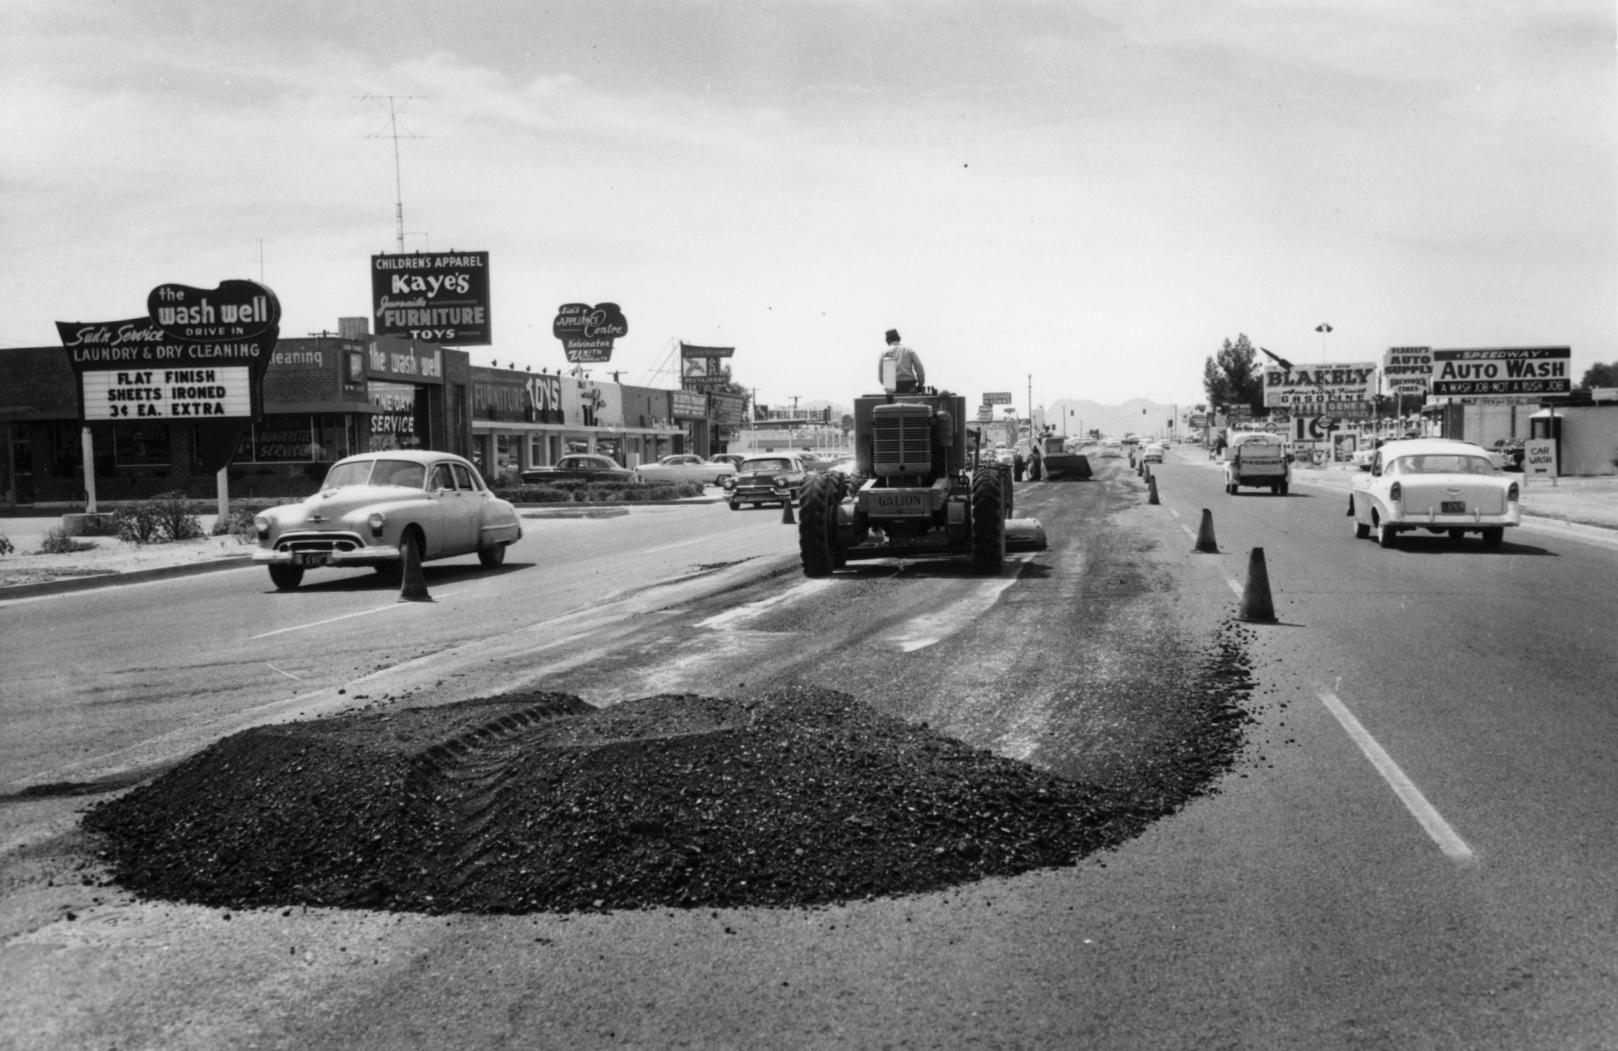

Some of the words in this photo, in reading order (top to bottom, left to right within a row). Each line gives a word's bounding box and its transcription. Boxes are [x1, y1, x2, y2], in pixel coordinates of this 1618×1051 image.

[376, 257, 432, 270] CHILDREN'S
[434, 255, 484, 269] APPAREL
[158, 287, 185, 301] the
[158, 298, 216, 326] wash
[221, 295, 268, 324] well
[384, 306, 486, 328] FURNITURE
[111, 324, 165, 346] Service
[185, 327, 226, 337] DRIVE
[231, 327, 245, 336] IN
[410, 328, 457, 340] TOYS
[74, 346, 139, 362] LAUNDRY
[143, 346, 152, 360] &
[156, 344, 183, 359] DRY
[188, 343, 261, 358] CLEANING
[269, 346, 323, 367] leaning
[368, 342, 387, 372] the
[1390, 355, 1432, 365] AUTO
[1462, 350, 1542, 360] SPEEDWAY
[117, 371, 153, 385] FLAT
[165, 369, 216, 384] FINISH
[1384, 364, 1433, 376] SUPPLY
[1441, 361, 1499, 380] AUTO
[1506, 359, 1565, 379] WASH
[1266, 368, 1374, 387] BLAKELY
[107, 387, 163, 402] SHEETS
[171, 385, 227, 400] IRONED
[1441, 383, 1448, 393] A
[1449, 382, 1473, 394] WASH
[1513, 381, 1519, 392] A
[1521, 380, 1544, 392] RUSH
[1546, 379, 1565, 391] JOB
[474, 382, 526, 412] FURNITURE
[526, 376, 560, 422] TOYS
[137, 403, 163, 417] EA.
[171, 402, 226, 416] EXTRA
[370, 414, 415, 433] SERVICE
[1529, 446, 1550, 456] CAR
[1528, 455, 1553, 465] WASH
[878, 495, 922, 507] GALION
